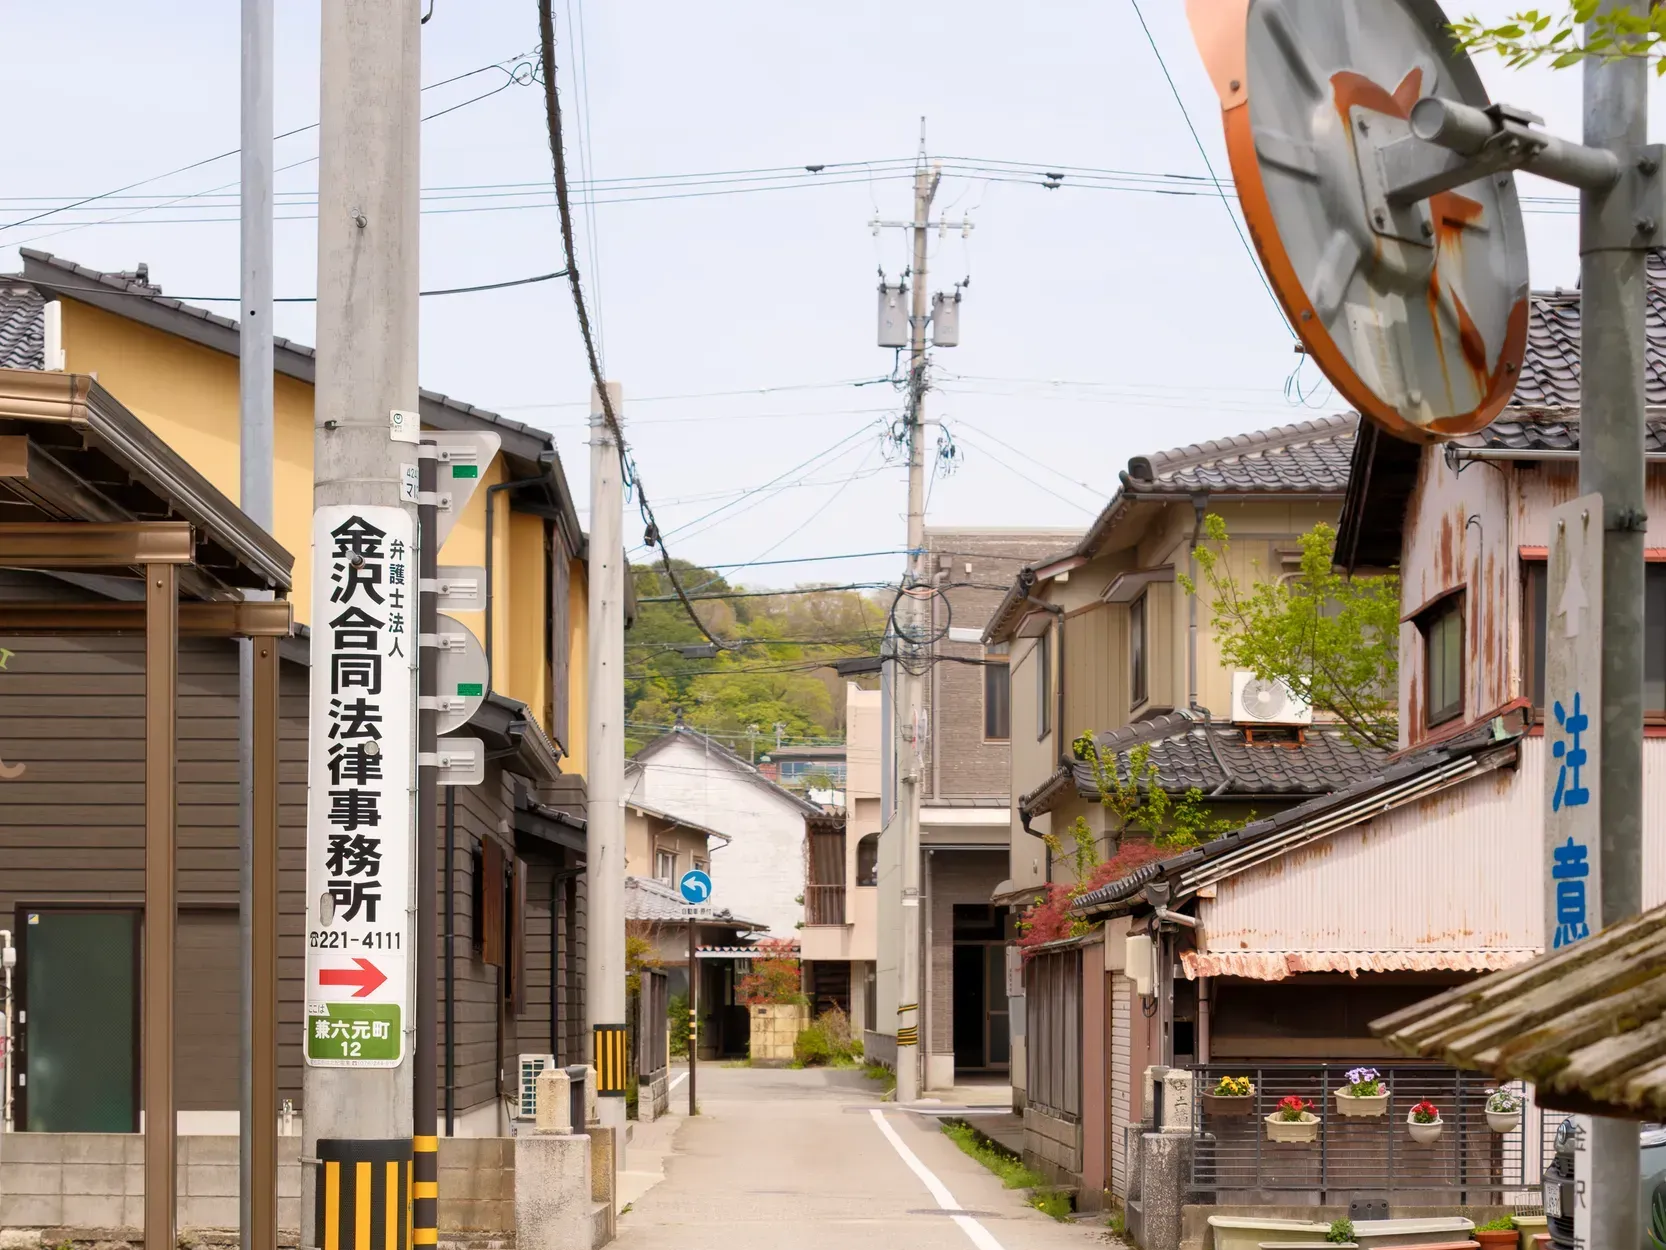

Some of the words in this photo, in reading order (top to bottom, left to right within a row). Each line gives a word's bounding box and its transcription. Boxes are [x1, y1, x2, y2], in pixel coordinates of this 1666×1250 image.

[389, 539, 405, 658] 弁護士法人
[325, 515, 387, 922] 金沢合同法律事務所
[1552, 691, 1590, 949] 注意
[319, 931, 401, 949] 221-4111
[309, 1004, 325, 1014] ここは
[315, 1019, 390, 1040] 兼六元町
[340, 1041, 362, 1057] 12
